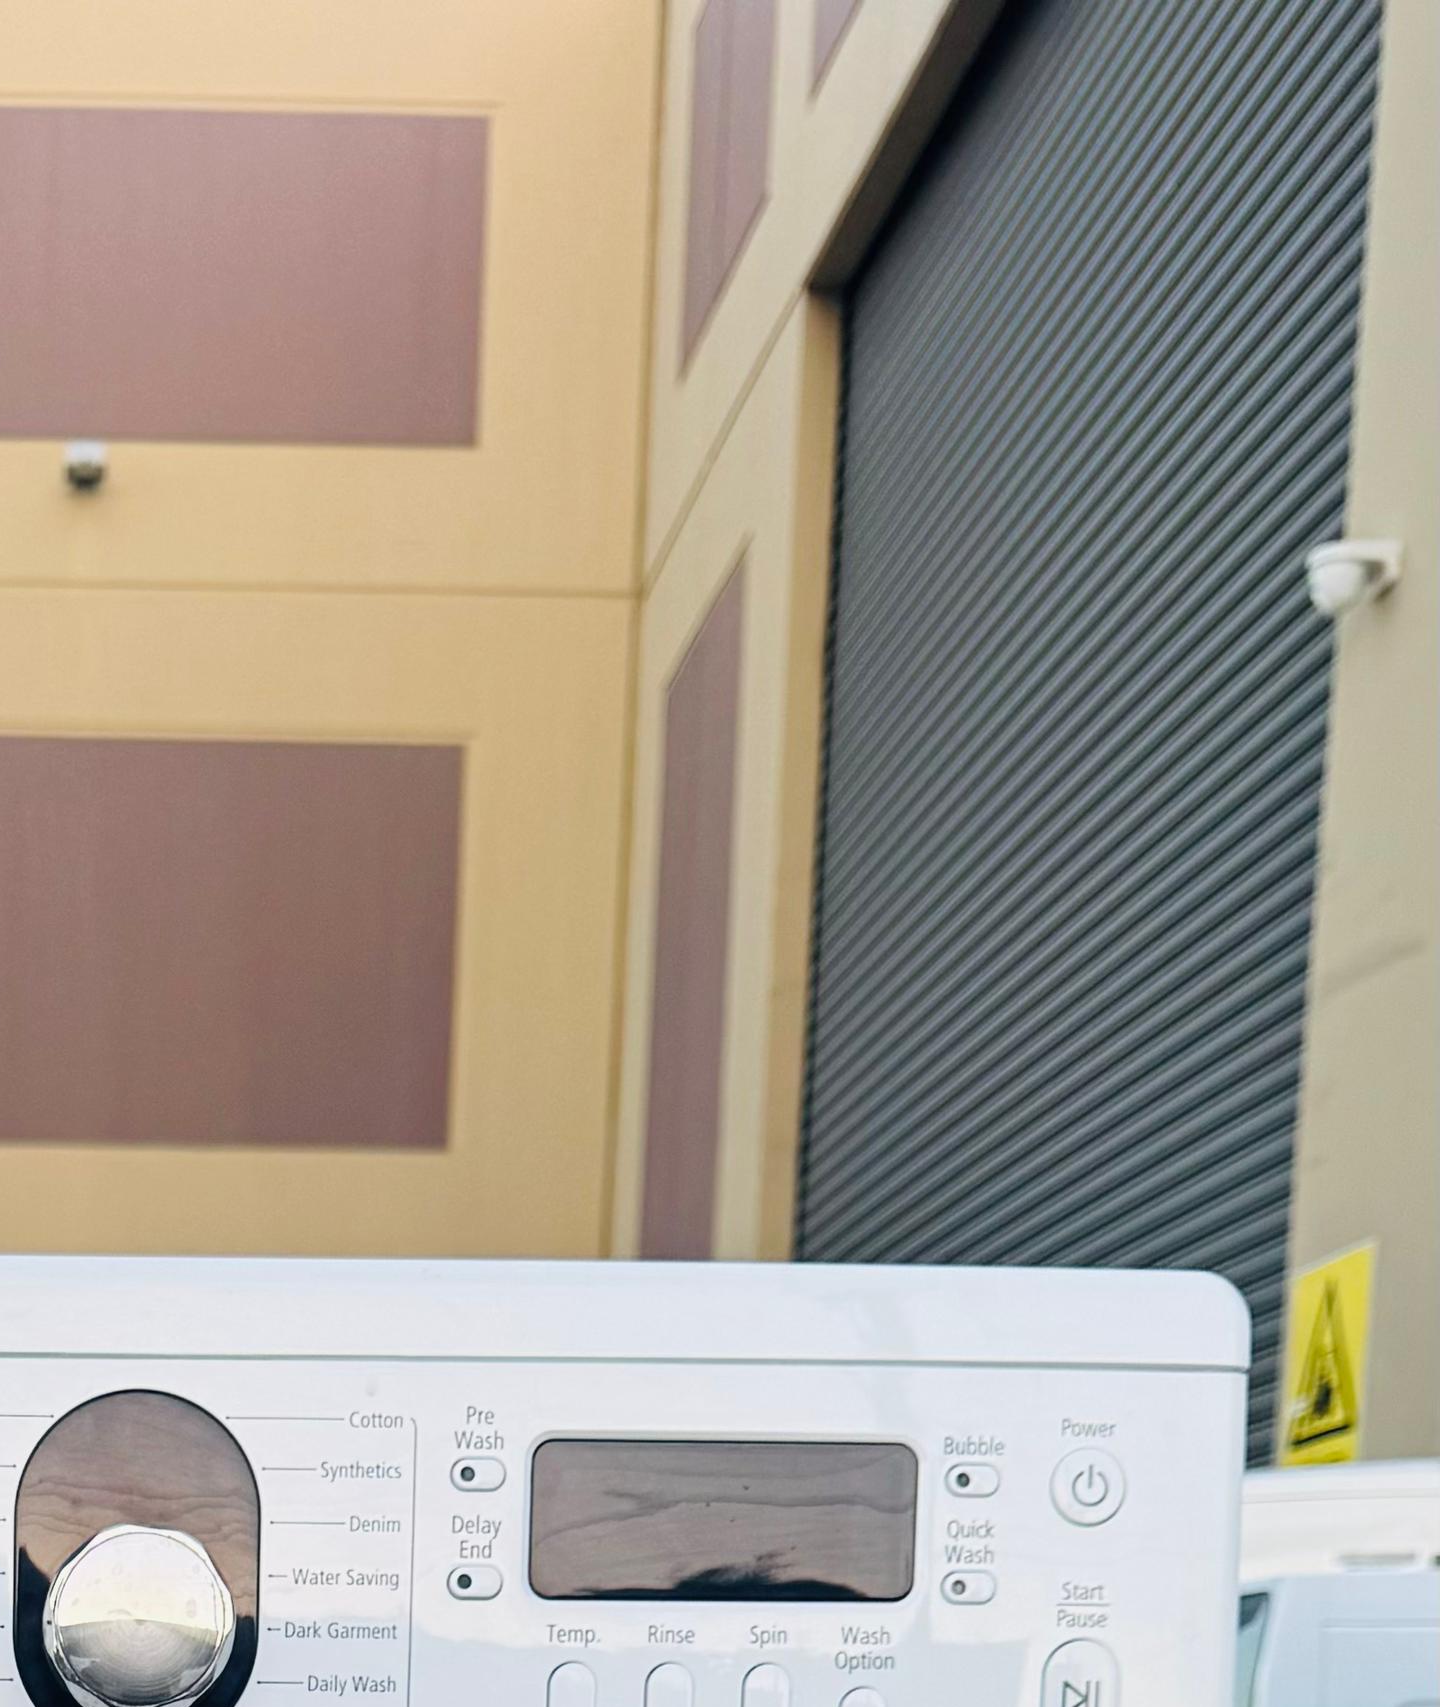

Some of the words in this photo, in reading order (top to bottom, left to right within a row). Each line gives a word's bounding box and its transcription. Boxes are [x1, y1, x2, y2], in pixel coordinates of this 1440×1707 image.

[348, 1411, 404, 1430] Cotton
[466, 1405, 495, 1425] Pre
[1060, 1418, 1117, 1438] Power
[454, 1431, 504, 1451] Wash
[943, 1436, 1005, 1457] Bubble
[320, 1460, 402, 1483] Synthetics
[349, 1515, 402, 1534] Denim
[451, 1515, 502, 1540] Delay
[946, 1519, 995, 1540] Quick
[459, 1540, 492, 1559] End
[944, 1545, 994, 1565] Wash
[292, 1569, 341, 1587] Water
[345, 1569, 400, 1591] Saving
[1060, 1581, 1105, 1601] Start
[1056, 1609, 1109, 1629] Pause
[283, 1621, 323, 1640] Dark
[327, 1622, 398, 1641] Garment
[546, 1624, 602, 1646] Temp.
[647, 1625, 696, 1645] Rinse
[749, 1625, 788, 1649] Spin
[841, 1626, 891, 1646] Wash
[834, 1651, 895, 1674] Option
[307, 1675, 348, 1696] Daily
[351, 1675, 397, 1694] Wash
